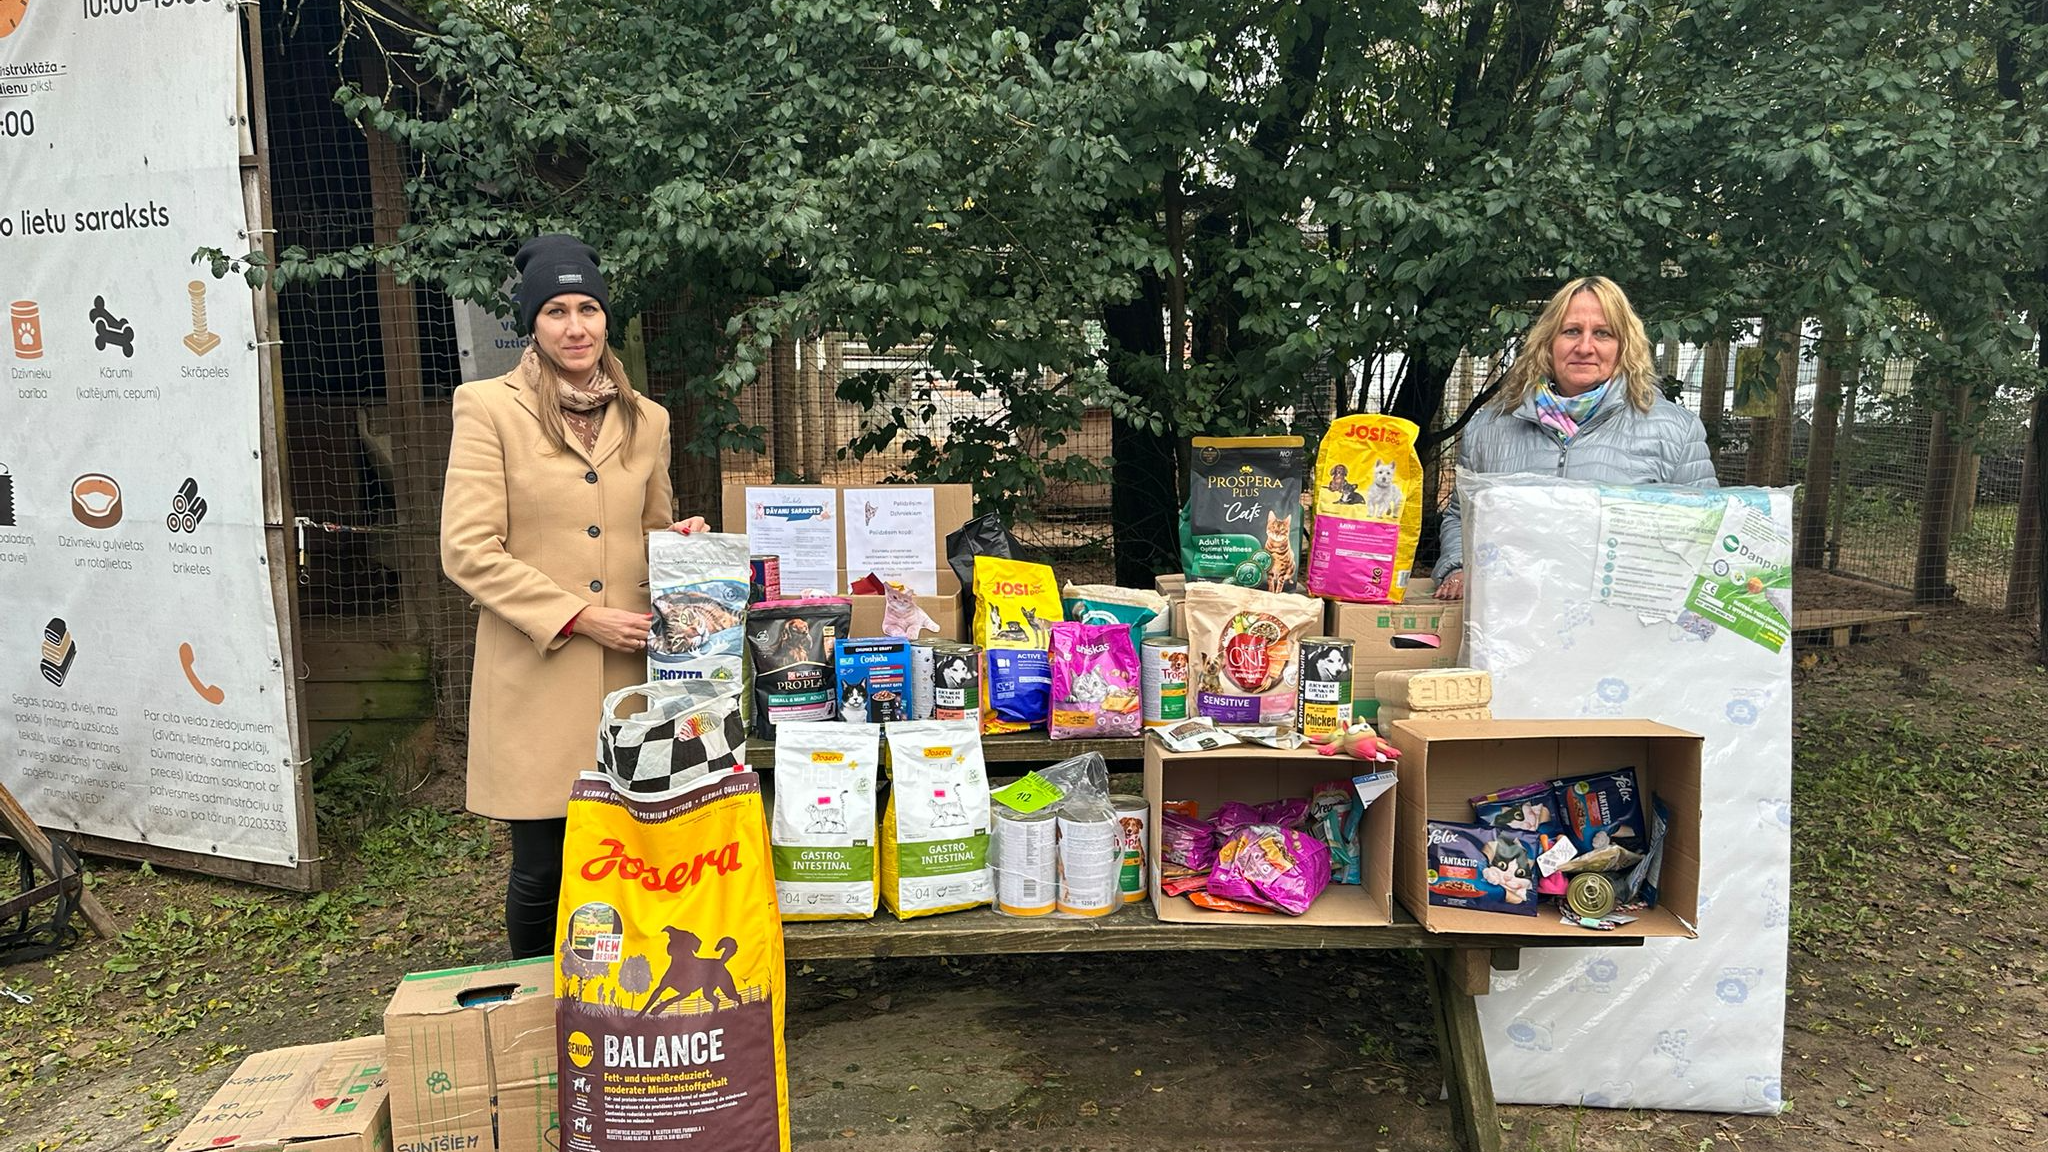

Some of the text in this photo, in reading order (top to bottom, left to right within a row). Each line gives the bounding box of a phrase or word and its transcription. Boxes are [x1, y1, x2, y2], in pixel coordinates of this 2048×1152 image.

[21, 208, 66, 235] lietu
[74, 200, 170, 232] saraksts
[11, 366, 52, 380] Dzīvnieku
[100, 366, 133, 379] Kārumi
[180, 365, 230, 380] Skrāpeles
[18, 387, 48, 400] barība
[76, 387, 161, 402] (kaltējumi, cepumi)
[1344, 424, 1386, 443] JOSI
[1208, 475, 1284, 489] PROSPERA
[1232, 487, 1260, 498] PLUS
[1225, 501, 1263, 523] Cats
[58, 535, 145, 552] Dzīvnieku guļvietas
[168, 541, 213, 555] Malka un
[1199, 538, 1220, 546] Adult
[75, 557, 133, 571] un rotaļlietas
[173, 562, 212, 576] briketes
[992, 581, 1029, 596] JOSI
[860, 653, 889, 664] Coshida
[1229, 646, 1267, 668] ONE
[796, 670, 820, 678] PURINA
[777, 681, 802, 690] PRO
[12, 693, 41, 708] Segas,
[97, 706, 118, 716] mazi
[1203, 695, 1250, 708] SENSITIVE
[144, 709, 161, 722] Par
[182, 714, 208, 727] veida
[210, 718, 275, 734] ziedojumiem
[1305, 713, 1337, 727] Chicken
[81, 721, 119, 735] uzsūcošs
[152, 728, 187, 744] (dīvāni,
[232, 740, 270, 755] paklāji,
[813, 752, 844, 762] Josera
[924, 748, 953, 758] Josera
[210, 757, 277, 774] saimniecības
[150, 766, 280, 793] preces) lūdzam saskaņot ar
[583, 789, 610, 799] GERMAN
[724, 783, 749, 795] QUALITY
[1611, 774, 1632, 804] felix
[150, 784, 201, 803] patversmes
[271, 804, 284, 814] uz
[638, 810, 668, 820] PREMIUM
[669, 802, 693, 817] PETFOOD
[1598, 790, 1612, 825] FANTASTIC
[174, 808, 189, 819] vai
[190, 811, 206, 821] pa
[238, 815, 288, 832] 20203333
[1427, 829, 1459, 848] felix
[800, 851, 845, 861] GASTRO-
[928, 843, 969, 855] GASTRO-
[580, 838, 743, 894] Josera
[792, 861, 852, 871] INTESTINAL
[920, 852, 976, 866] INTESTINAL
[1440, 856, 1478, 868] FANTASTIC
[785, 893, 800, 904] 04
[596, 940, 621, 952] NEW
[595, 952, 619, 961] DESIGN
[567, 1041, 594, 1058] SENIOR
[604, 1028, 726, 1069] BALANCE
[604, 1069, 713, 1083] Fett- und eiweißreduziert,
[604, 1077, 729, 1095] moderater Mineralstoffgehalt
[193, 1110, 264, 1125] ARNO
